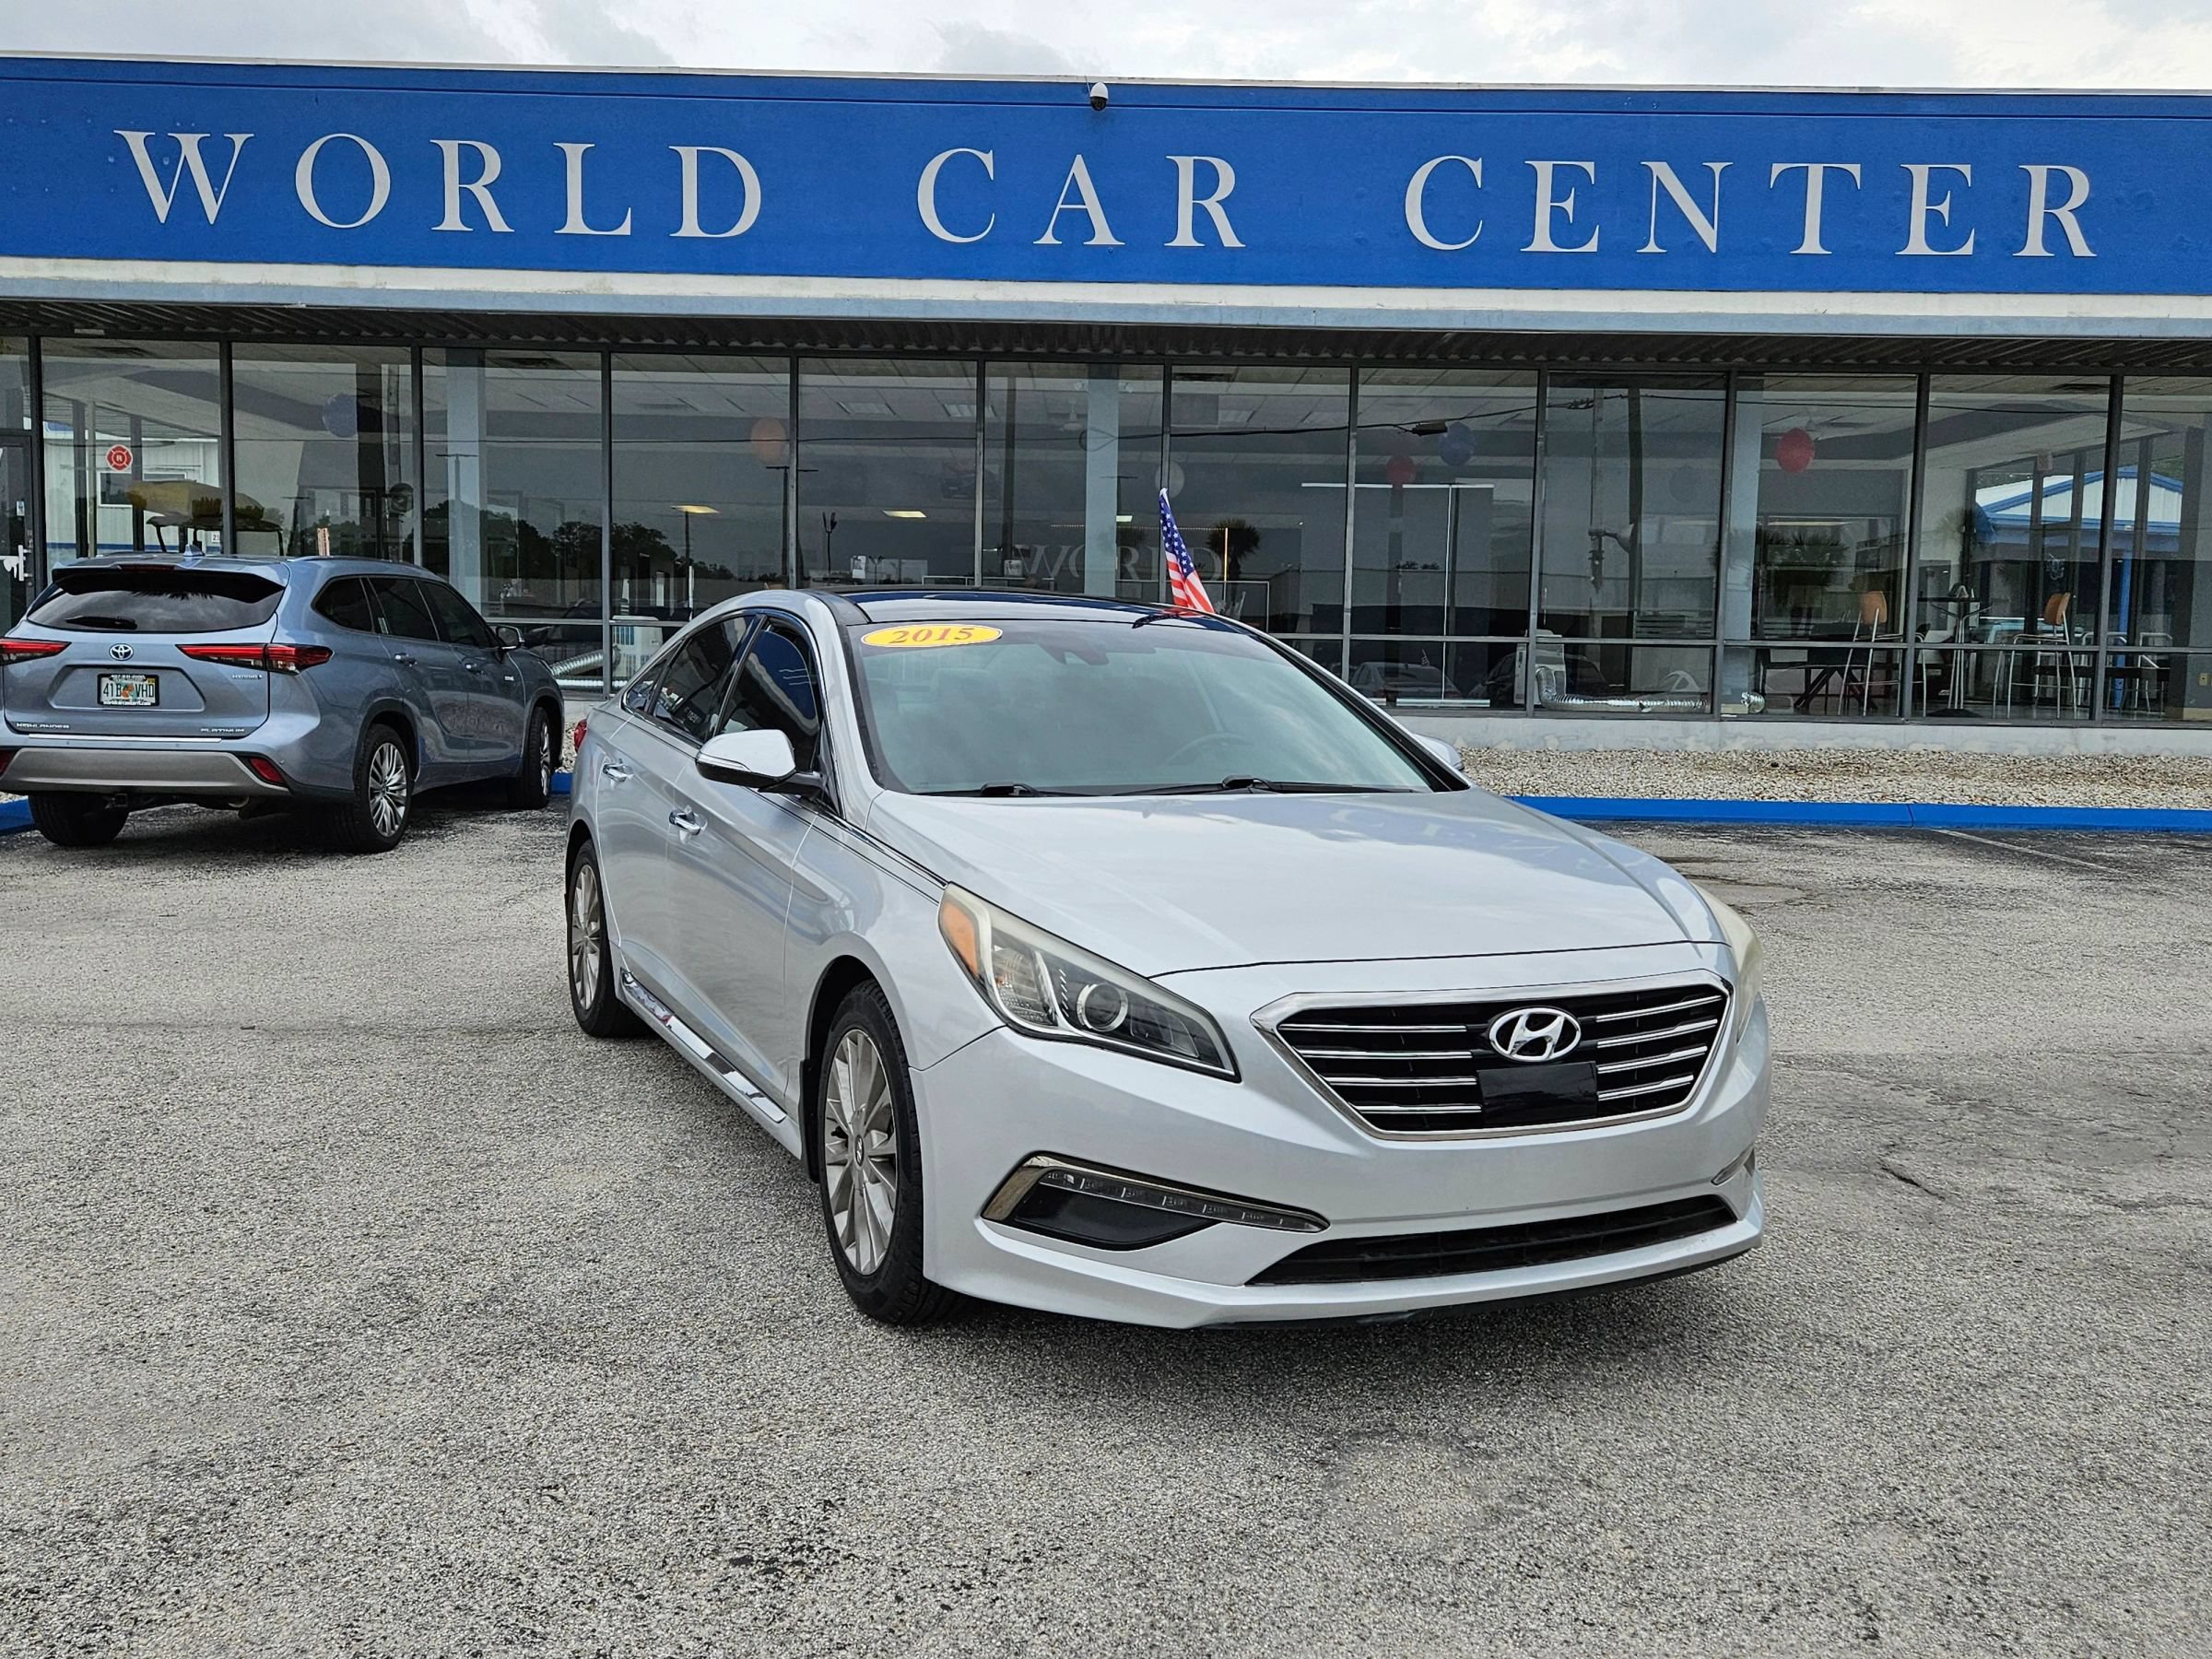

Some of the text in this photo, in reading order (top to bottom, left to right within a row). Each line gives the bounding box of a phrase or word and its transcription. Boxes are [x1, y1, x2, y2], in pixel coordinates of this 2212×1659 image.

[113, 130, 2097, 256] WORLD CAR CENTER
[888, 628, 975, 644] 2015
